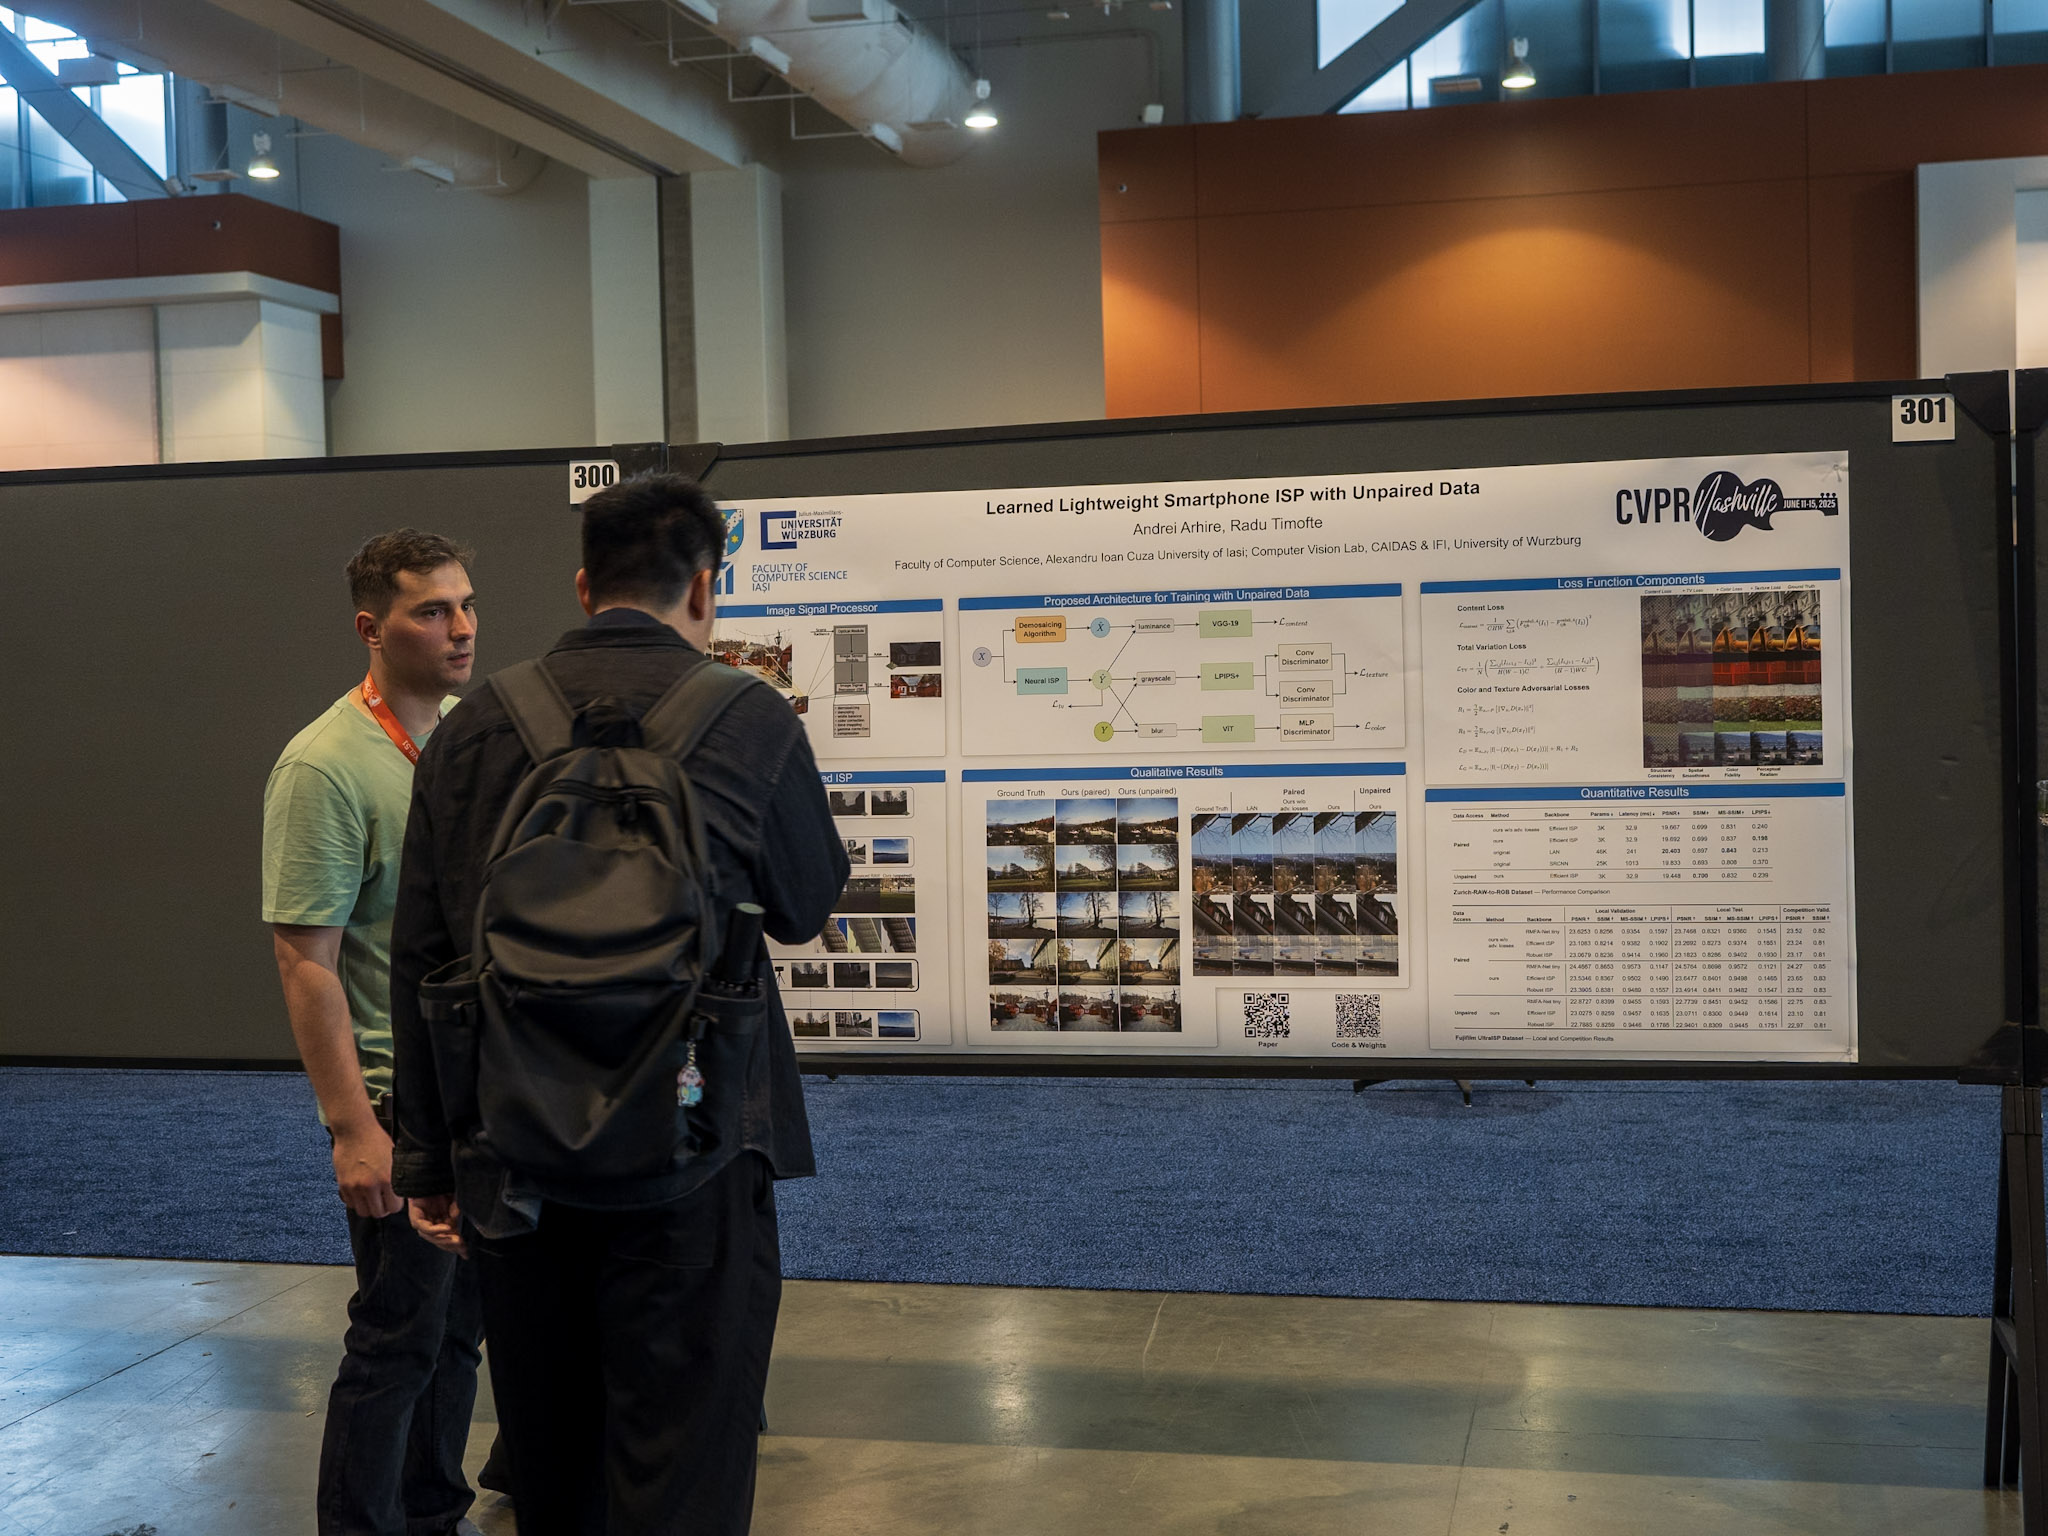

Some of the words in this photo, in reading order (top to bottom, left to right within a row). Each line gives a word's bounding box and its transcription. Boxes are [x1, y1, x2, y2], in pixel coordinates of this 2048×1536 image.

[1900, 398, 1946, 424] 301
[574, 464, 614, 488] 300
[986, 498, 1054, 515] Learned
[1059, 494, 1159, 514] Lightweight
[1164, 489, 1270, 509] Smartphone
[1276, 489, 1304, 503] ISP
[1310, 486, 1347, 501] with
[1352, 483, 1433, 503] Unpaired
[1440, 482, 1480, 496] Data
[1783, 500, 1800, 508] JUNE
[1801, 500, 1817, 509] 11-15,
[1819, 499, 1836, 508] 2025
[1616, 487, 1690, 525] CVPR
[1694, 474, 1779, 538] Nashville
[781, 517, 842, 529] UNIVERSITÄT
[1133, 522, 1177, 536] Andrei
[1180, 519, 1225, 535] Arhire,
[1230, 518, 1268, 532] Radu
[1271, 516, 1323, 530] Timofte
[782, 529, 836, 540] WÜRZBURG
[895, 560, 930, 571] Faculty
[934, 559, 943, 568] of
[946, 556, 996, 570] Computer
[999, 555, 1043, 567] Science,
[1046, 553, 1098, 564] Alexandru
[1101, 552, 1124, 562] Ioan
[1127, 551, 1154, 561] Cuza
[1157, 549, 1210, 561] University
[1212, 547, 1223, 558] of
[1226, 546, 1248, 559] Iasi;
[1251, 544, 1304, 560] Computer
[1308, 543, 1341, 555] Vision
[1344, 542, 1367, 554] Lab,
[1371, 540, 1417, 553] CAIDAS
[1421, 540, 1429, 550] &
[1432, 539, 1449, 551] IFI,
[1454, 537, 1509, 551] University
[1513, 535, 1524, 548] of
[1526, 535, 1582, 548] Wurzburg
[752, 564, 792, 573] FACULTY
[795, 563, 807, 572] OF
[752, 572, 805, 582] COMPUTER
[809, 571, 848, 580] SCIENCE
[1558, 578, 1583, 588] Loss
[1587, 577, 1632, 588] Function
[1636, 574, 1705, 586] Components
[1044, 596, 1090, 607] Proposed
[1092, 594, 1151, 604] Architecture
[1154, 593, 1168, 603] for
[1170, 592, 1210, 603] Training
[1214, 591, 1233, 600] with
[1236, 590, 1282, 601] Unpaired
[1285, 589, 1309, 598] Data
[766, 605, 796, 618] Image
[798, 604, 827, 616] Signal
[830, 604, 878, 613] Processor
[1019, 621, 1062, 630] Demosaicing
[1024, 630, 1056, 638] Algorithm
[1141, 675, 1171, 683] grayscale
[1283, 728, 1330, 736] Discriminator
[835, 773, 852, 782] ISP
[1130, 767, 1183, 778] Qualitative
[1186, 767, 1224, 776] Results
[1118, 787, 1136, 795] Ours
[1138, 787, 1177, 795] (unpaired)
[1359, 787, 1391, 795] Unpaired
[1581, 787, 1645, 799] Quantitative
[1649, 787, 1689, 797] Results
